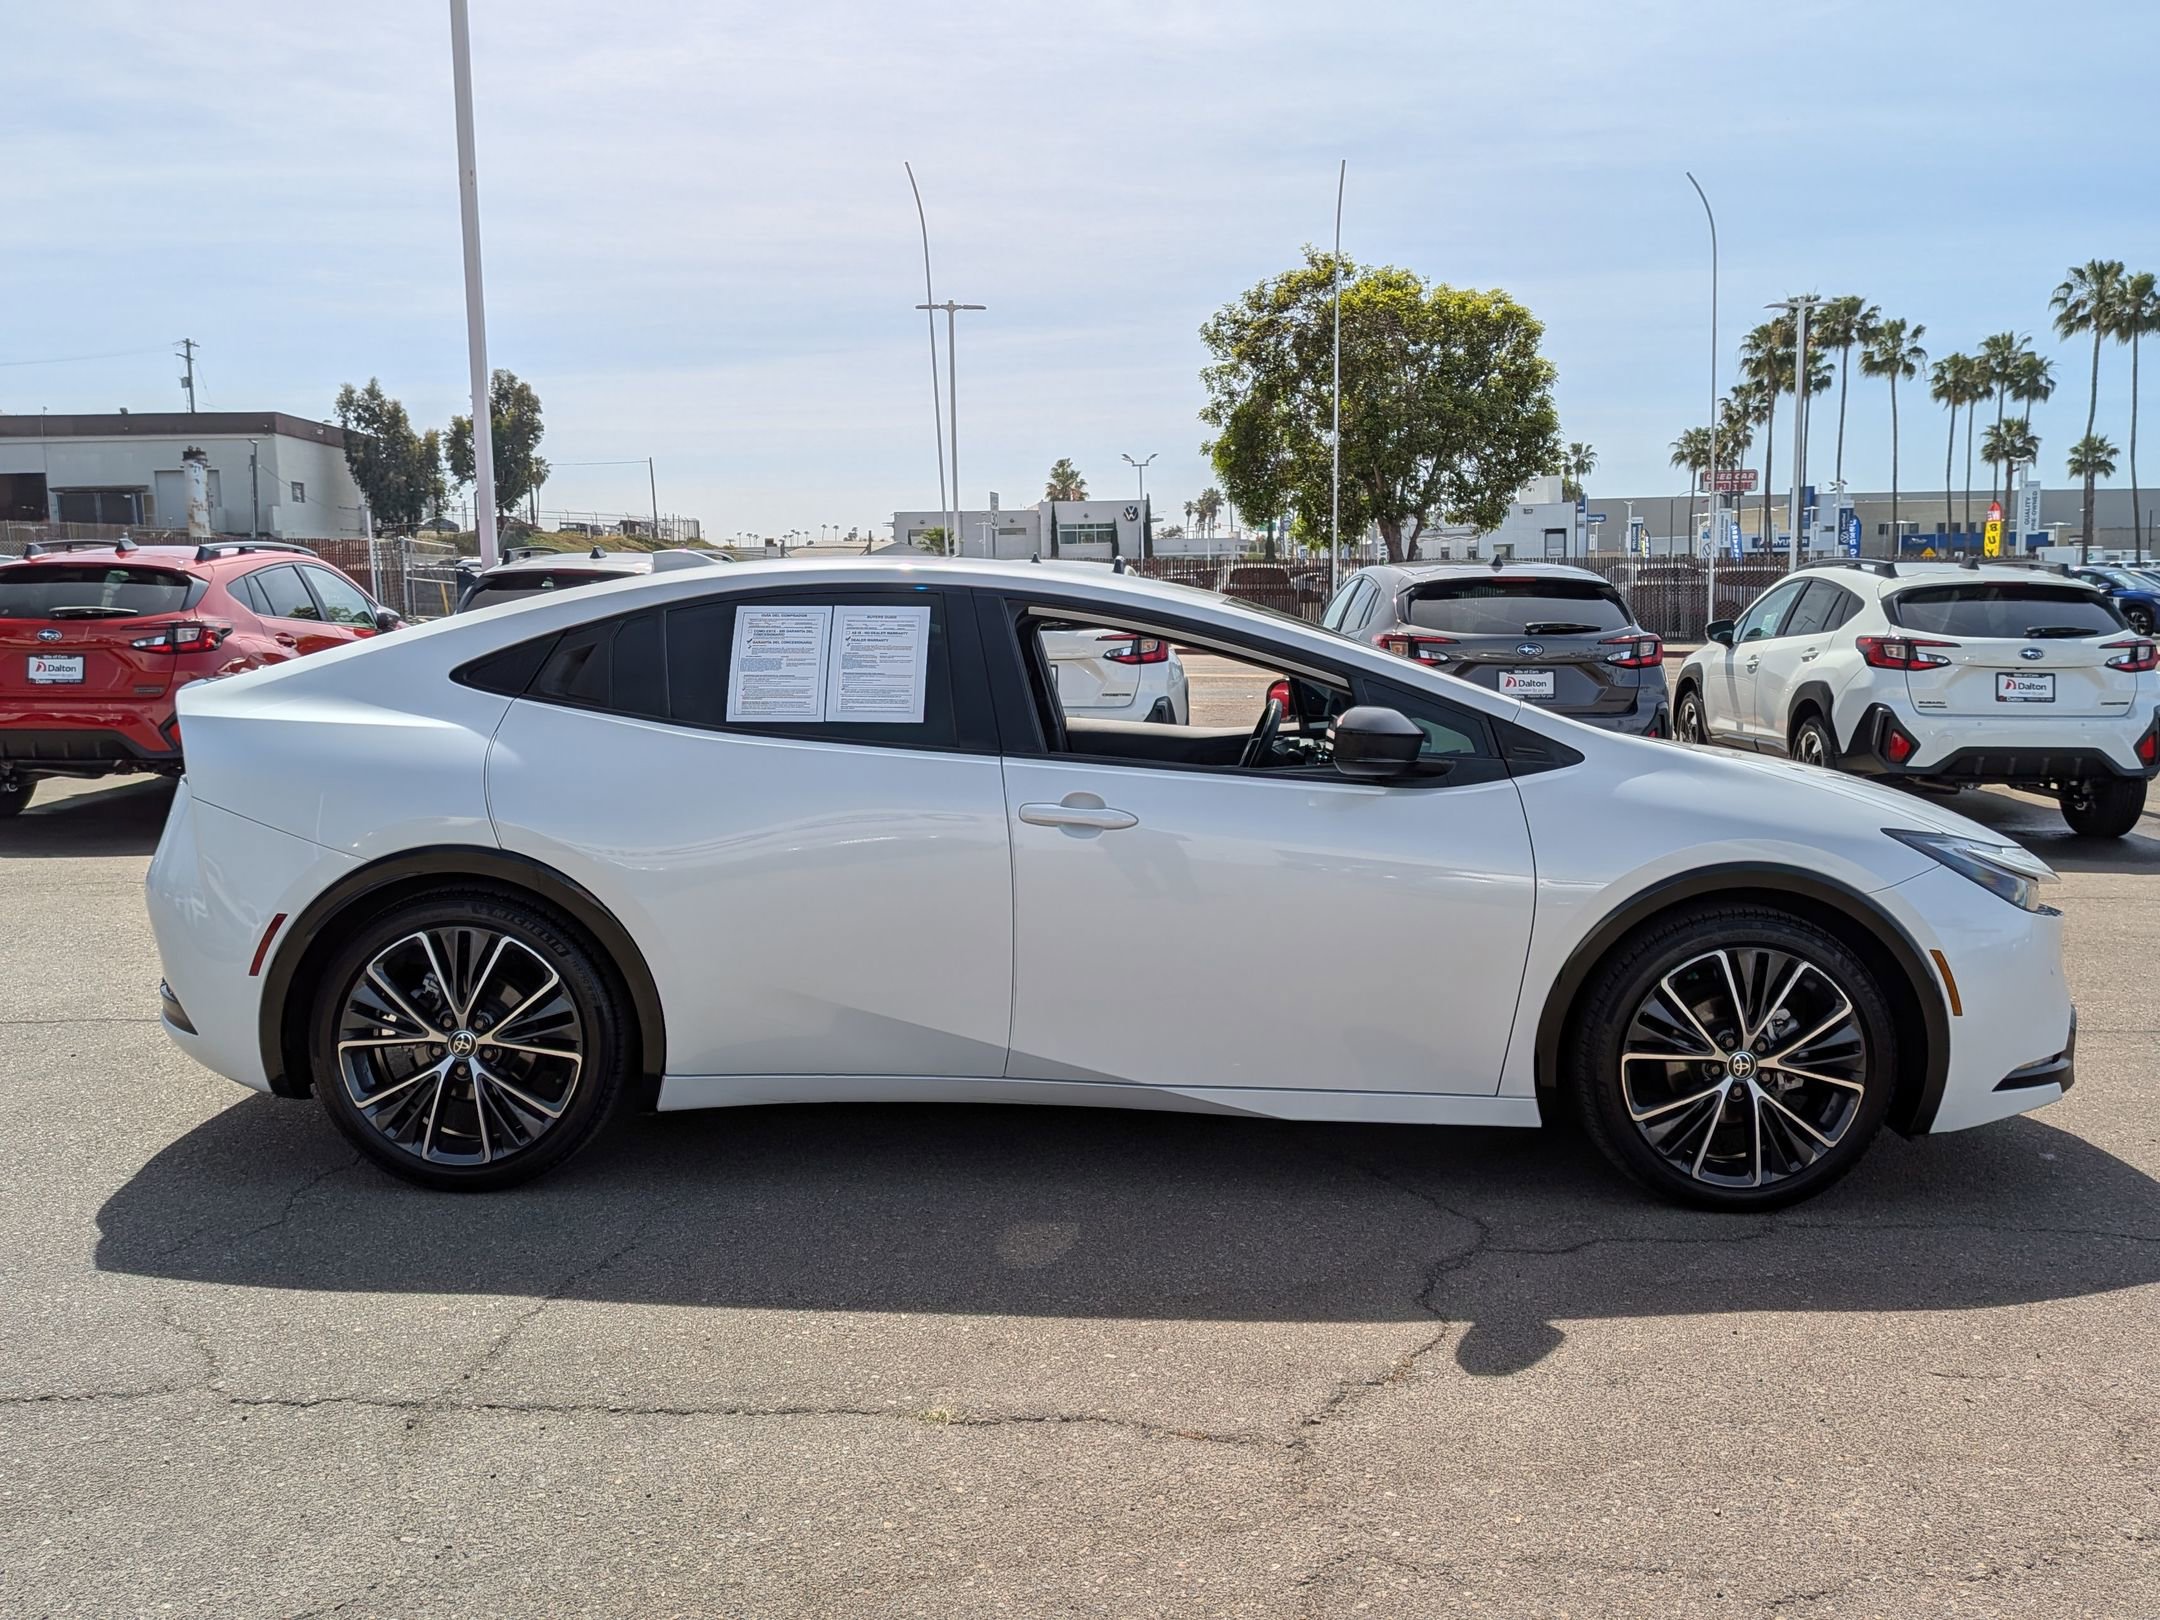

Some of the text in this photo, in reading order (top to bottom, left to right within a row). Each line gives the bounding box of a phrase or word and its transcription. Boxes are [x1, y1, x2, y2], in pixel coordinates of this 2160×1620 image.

[1706, 472, 1755, 480] UED CAR
[48, 664, 77, 672] Dalton
[1518, 680, 1547, 688] Dalton
[492, 908, 567, 954] MICHELIN
